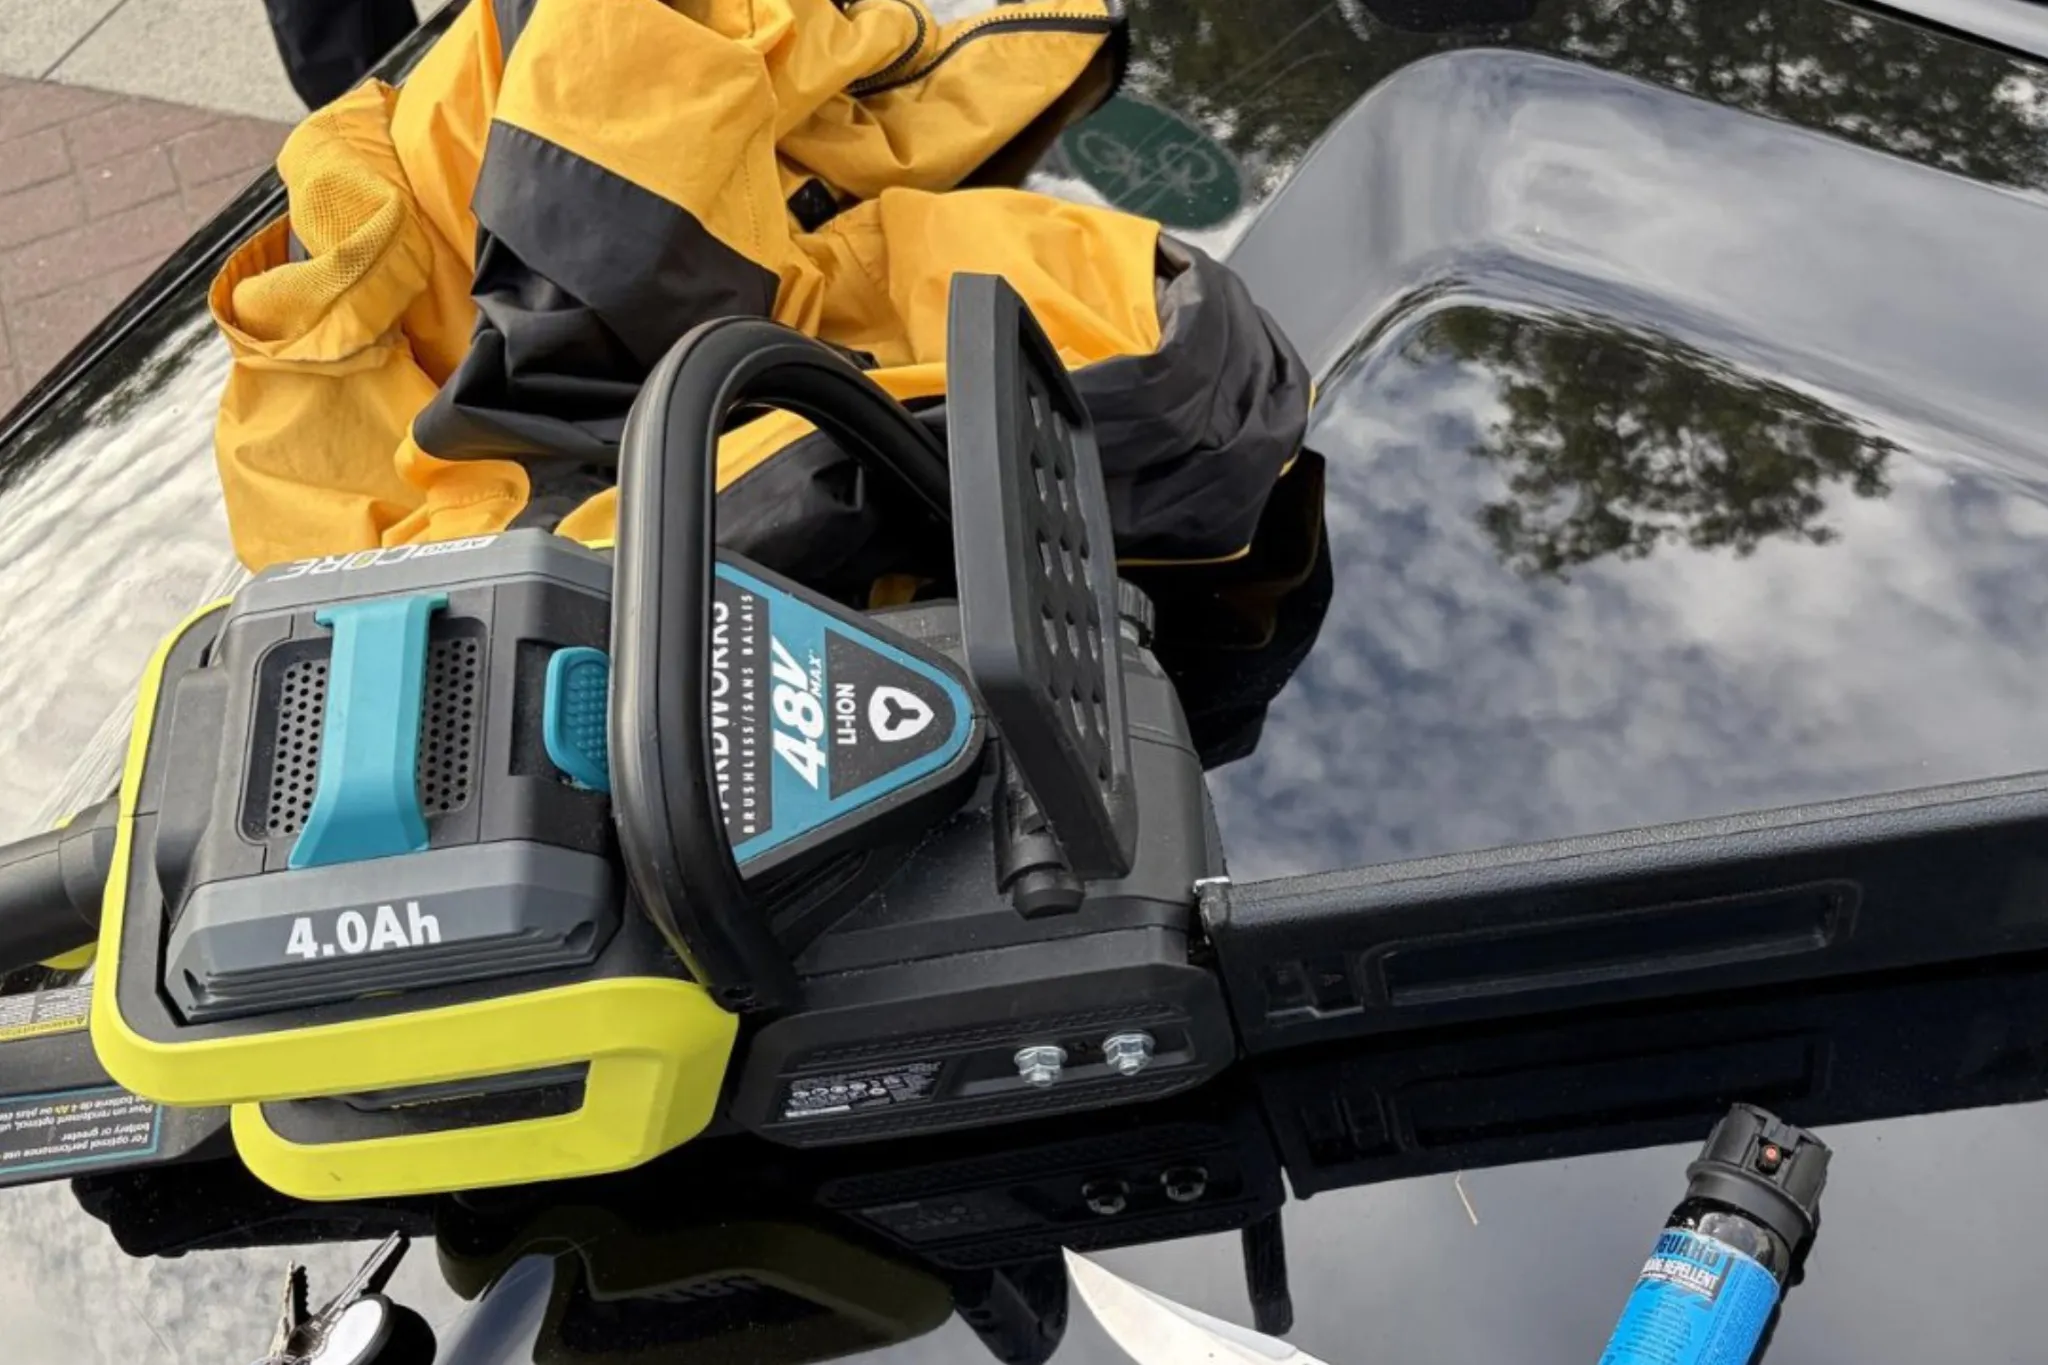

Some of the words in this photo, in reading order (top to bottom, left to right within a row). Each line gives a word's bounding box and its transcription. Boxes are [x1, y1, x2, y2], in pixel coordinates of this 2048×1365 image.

[740, 595, 754, 656] BALAIS
[772, 634, 826, 791] 48V
[836, 683, 857, 745] LI-ION
[741, 667, 756, 834] BRUSHLESS/SANS
[285, 901, 442, 959] 4.0Ah
[23, 1140, 88, 1157] performance
[90, 1136, 129, 1150] optimal
[114, 1122, 150, 1134] battery
[131, 1134, 148, 1144] For
